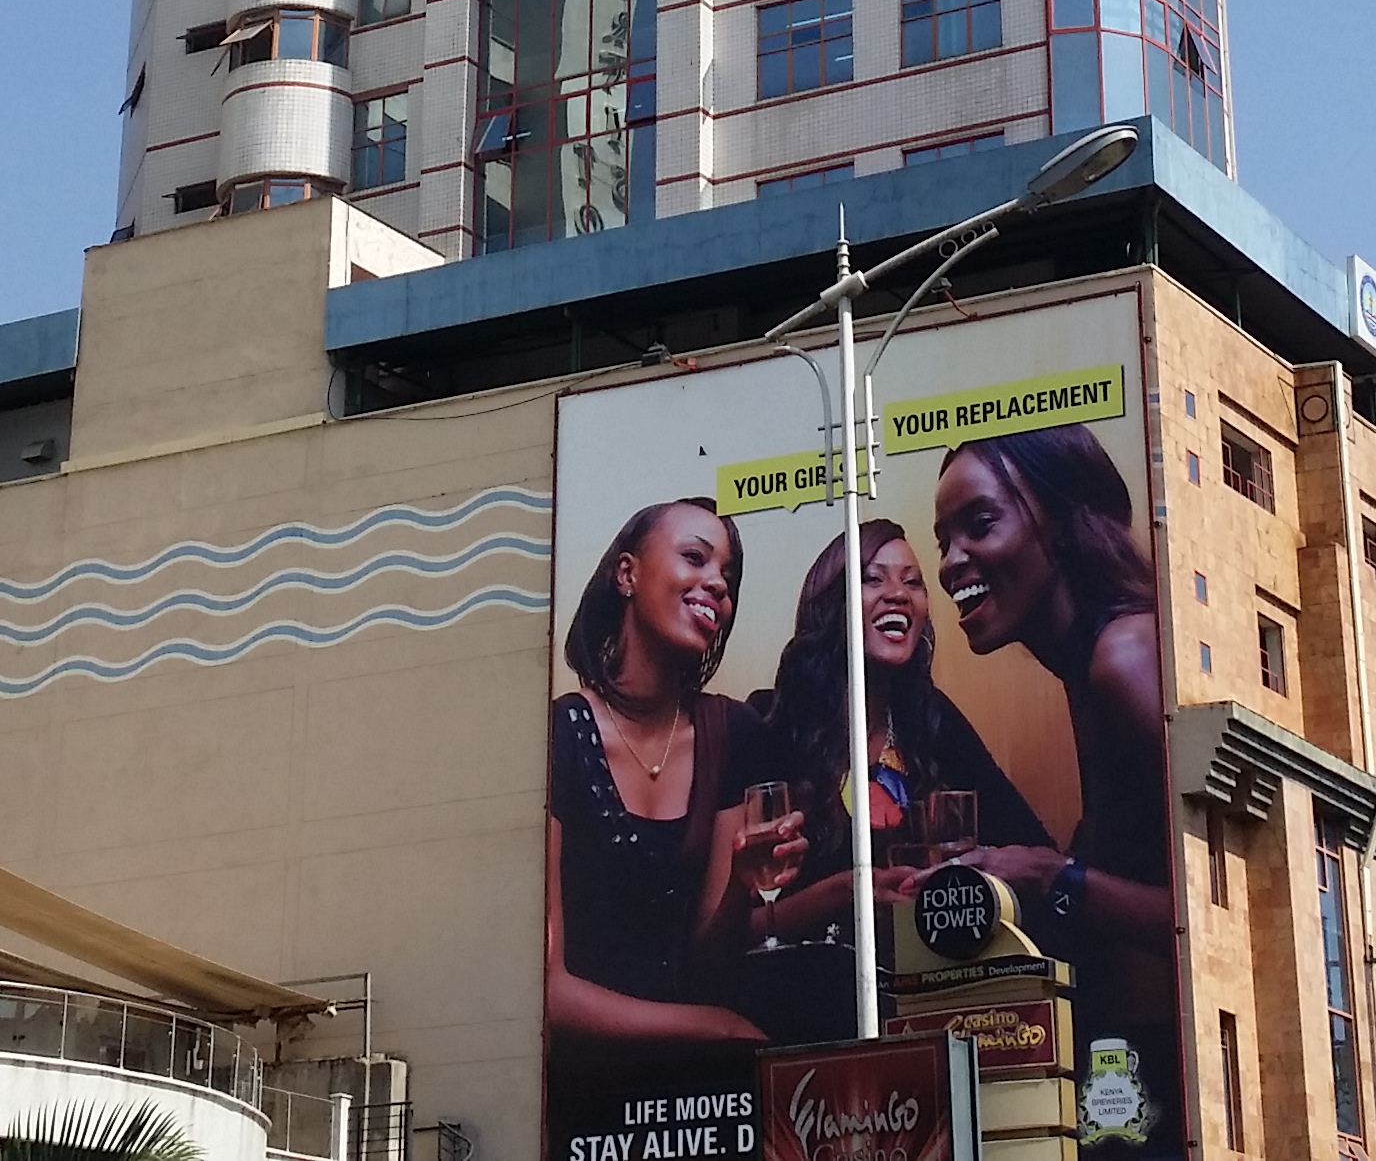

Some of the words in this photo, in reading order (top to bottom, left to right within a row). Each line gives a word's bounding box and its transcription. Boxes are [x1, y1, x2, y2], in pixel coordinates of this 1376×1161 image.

[893, 409, 949, 437] YOUR
[955, 380, 1112, 427] REPLACEMENT
[733, 471, 788, 499] YOUR
[794, 462, 845, 489] GIR
[923, 884, 984, 909] FORTIS
[922, 908, 987, 931] TOWER
[921, 965, 984, 984] PROPERTIES
[988, 961, 1045, 977] Development
[1100, 1055, 1121, 1065] KBL
[1091, 1097, 1133, 1106] BREWERIES
[1100, 1088, 1123, 1096] KENYA
[624, 1098, 668, 1126] LIFE
[675, 1092, 753, 1122] MOVES
[1098, 1108, 1126, 1116] LIMITED
[569, 1133, 634, 1161] STAY
[642, 1125, 727, 1161] ALIVE.
